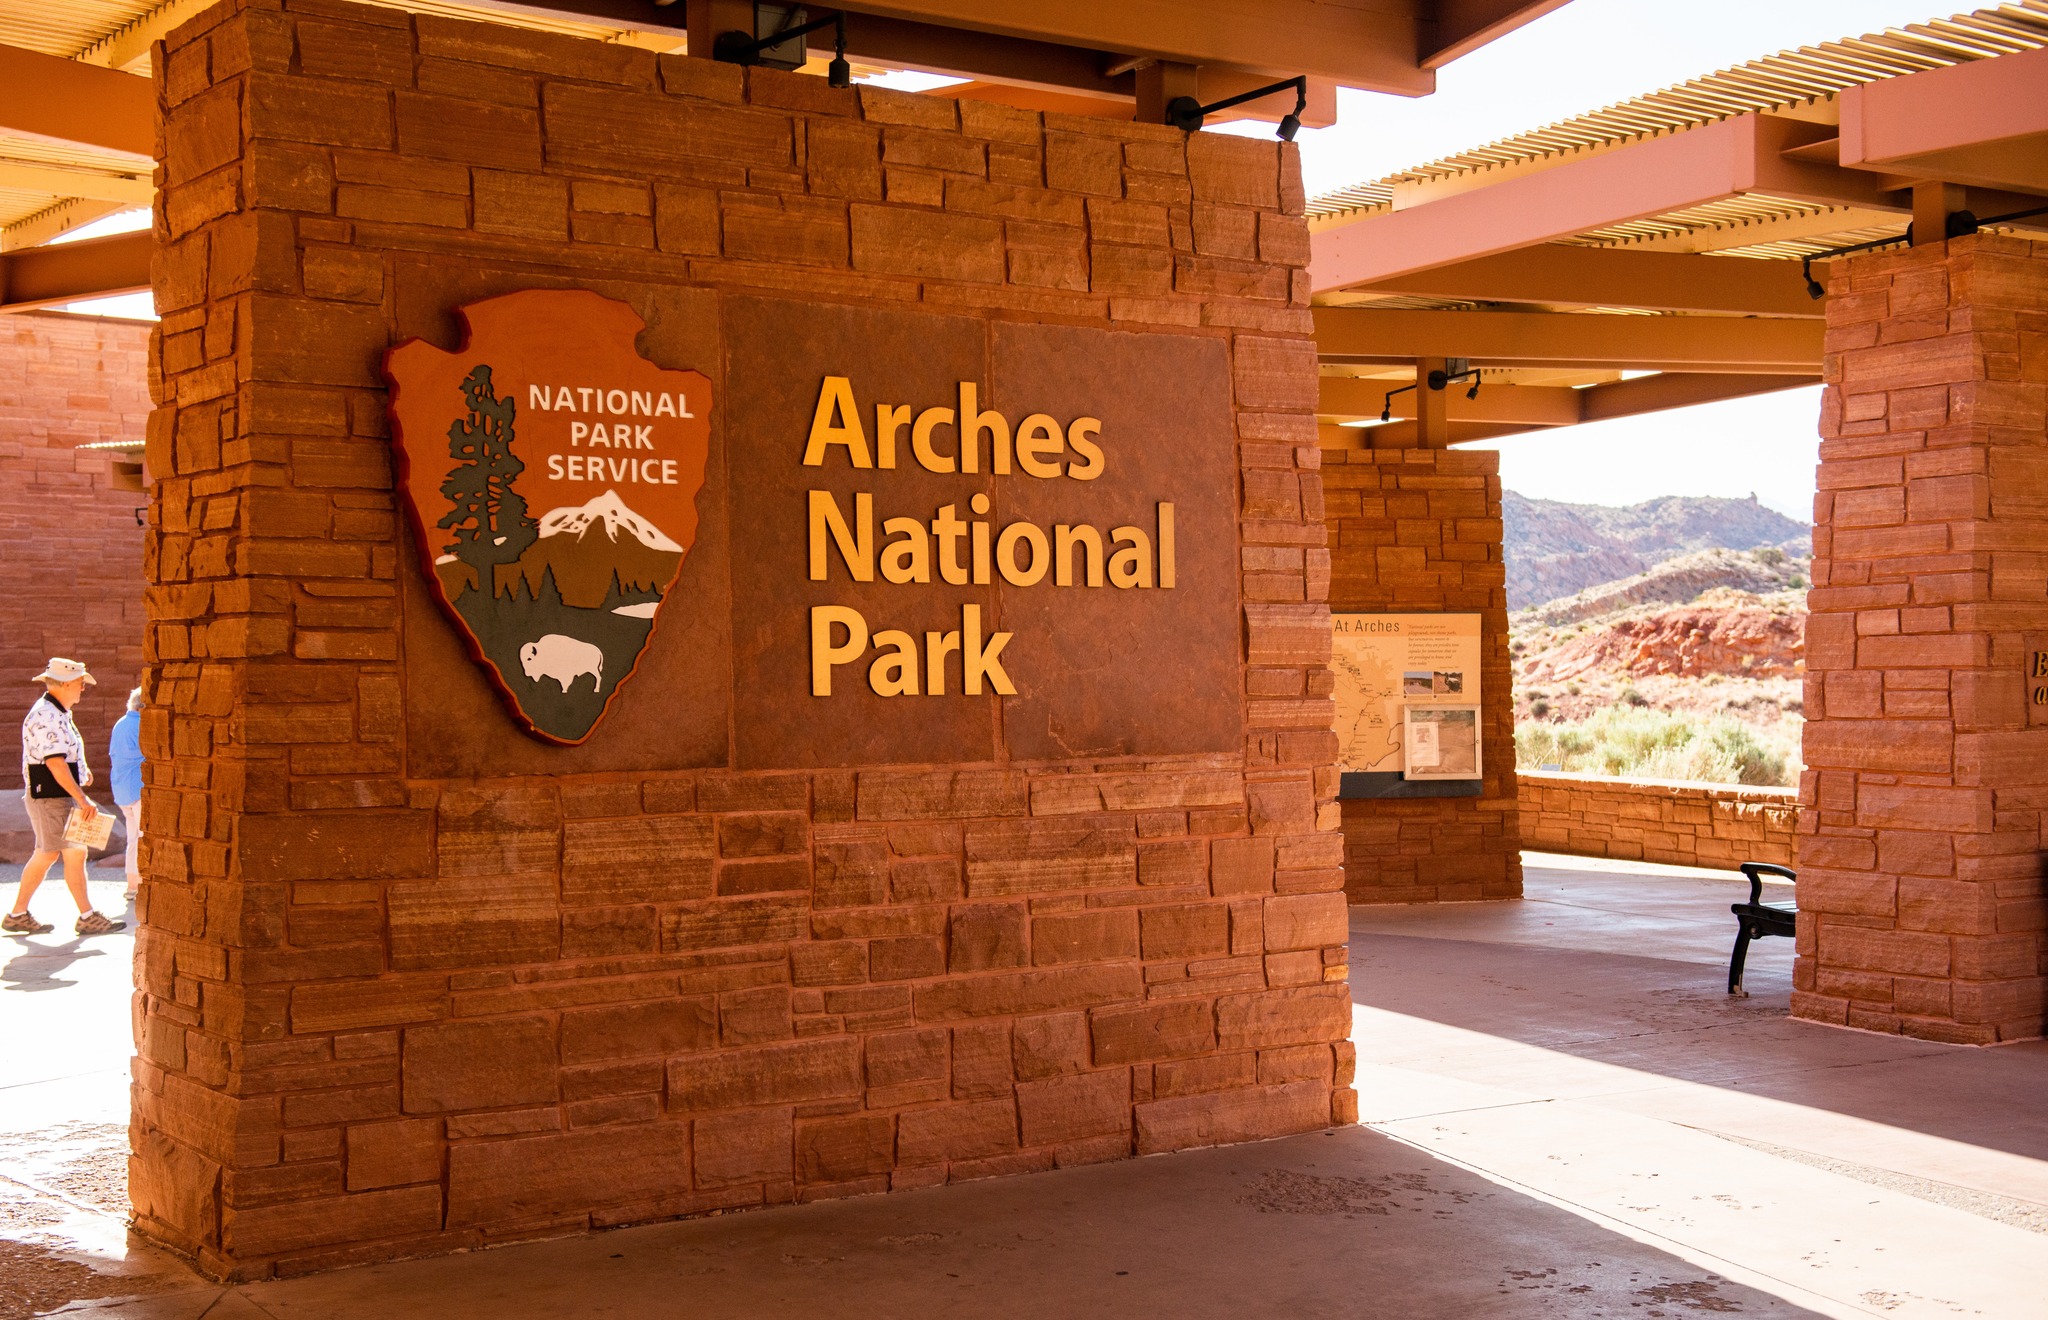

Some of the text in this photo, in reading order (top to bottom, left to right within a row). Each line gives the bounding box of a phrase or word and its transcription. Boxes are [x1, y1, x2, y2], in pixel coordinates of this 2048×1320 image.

[528, 383, 695, 419] NATIONAL
[570, 421, 655, 450] PARK
[801, 375, 1106, 481] Arches
[546, 454, 679, 485] SERVICE
[808, 489, 1176, 590] National
[1334, 619, 1349, 632] At
[1354, 619, 1400, 632] Arches
[810, 603, 1019, 697] Park
